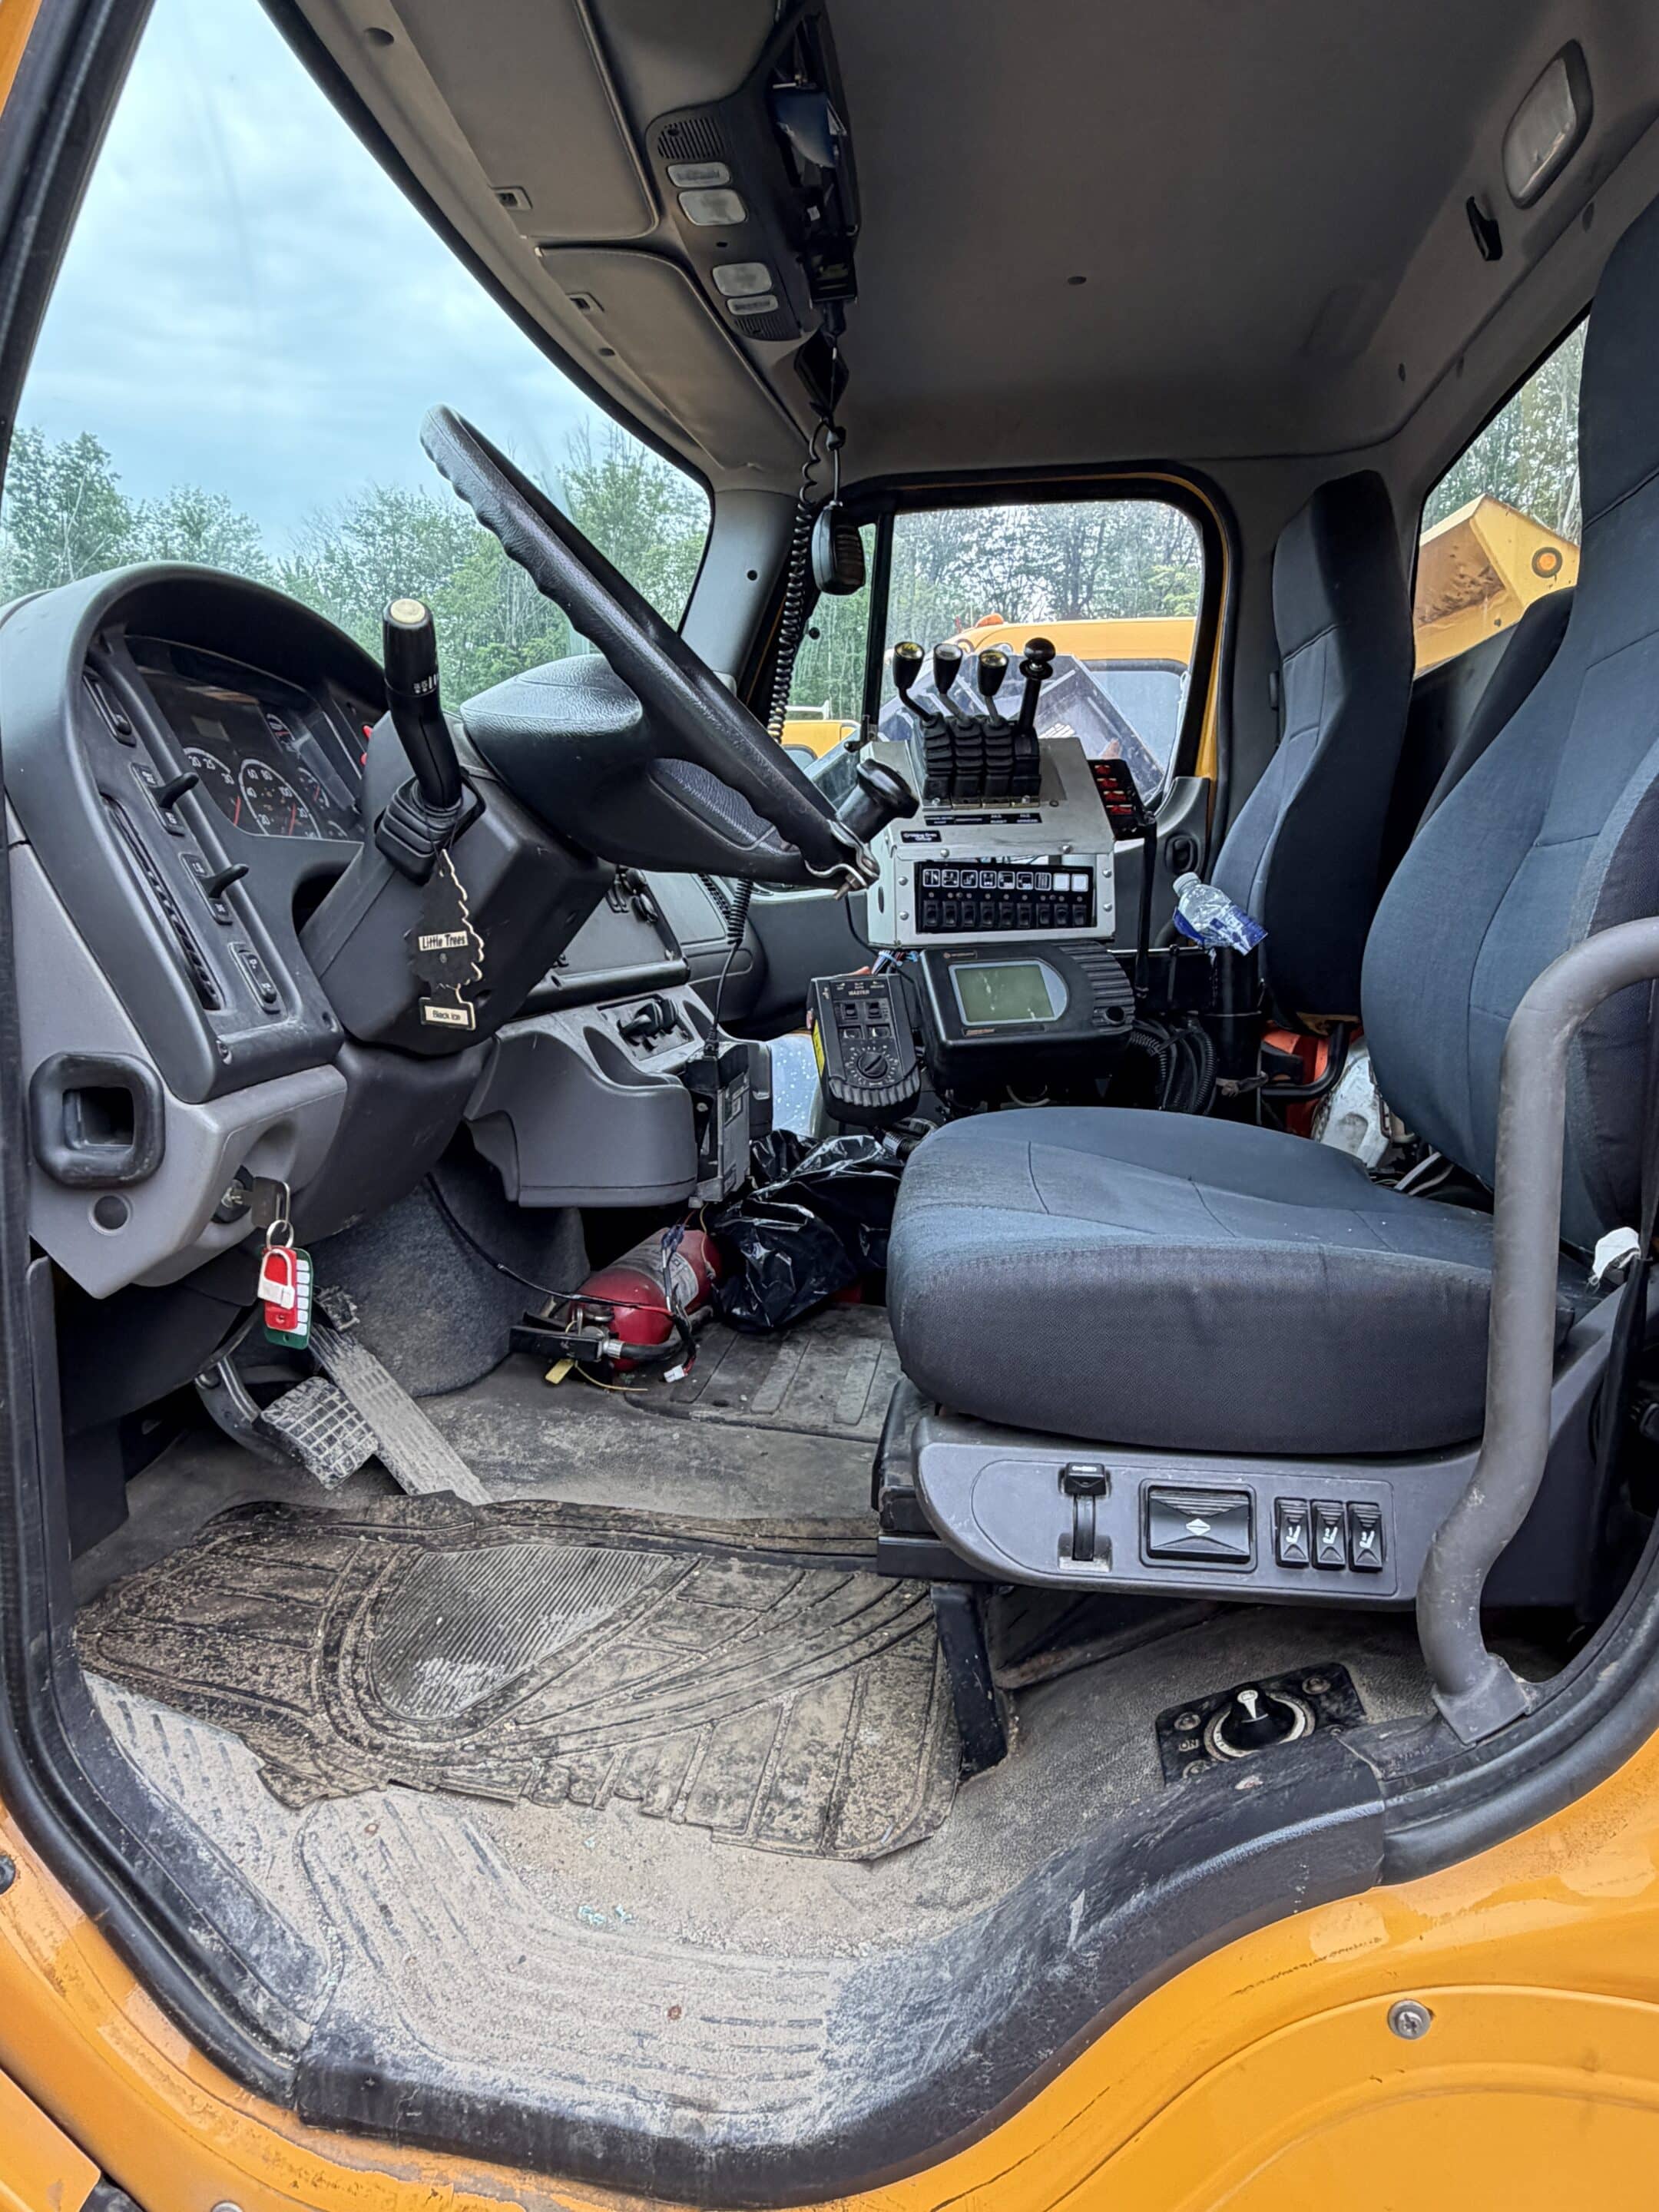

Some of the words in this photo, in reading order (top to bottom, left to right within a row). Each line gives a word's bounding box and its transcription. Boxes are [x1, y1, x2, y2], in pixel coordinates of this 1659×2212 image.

[422, 935, 443, 949] Little
[445, 933, 466, 947] Trees
[432, 1009, 450, 1020] Black
[1180, 1739, 1197, 1750] ON
